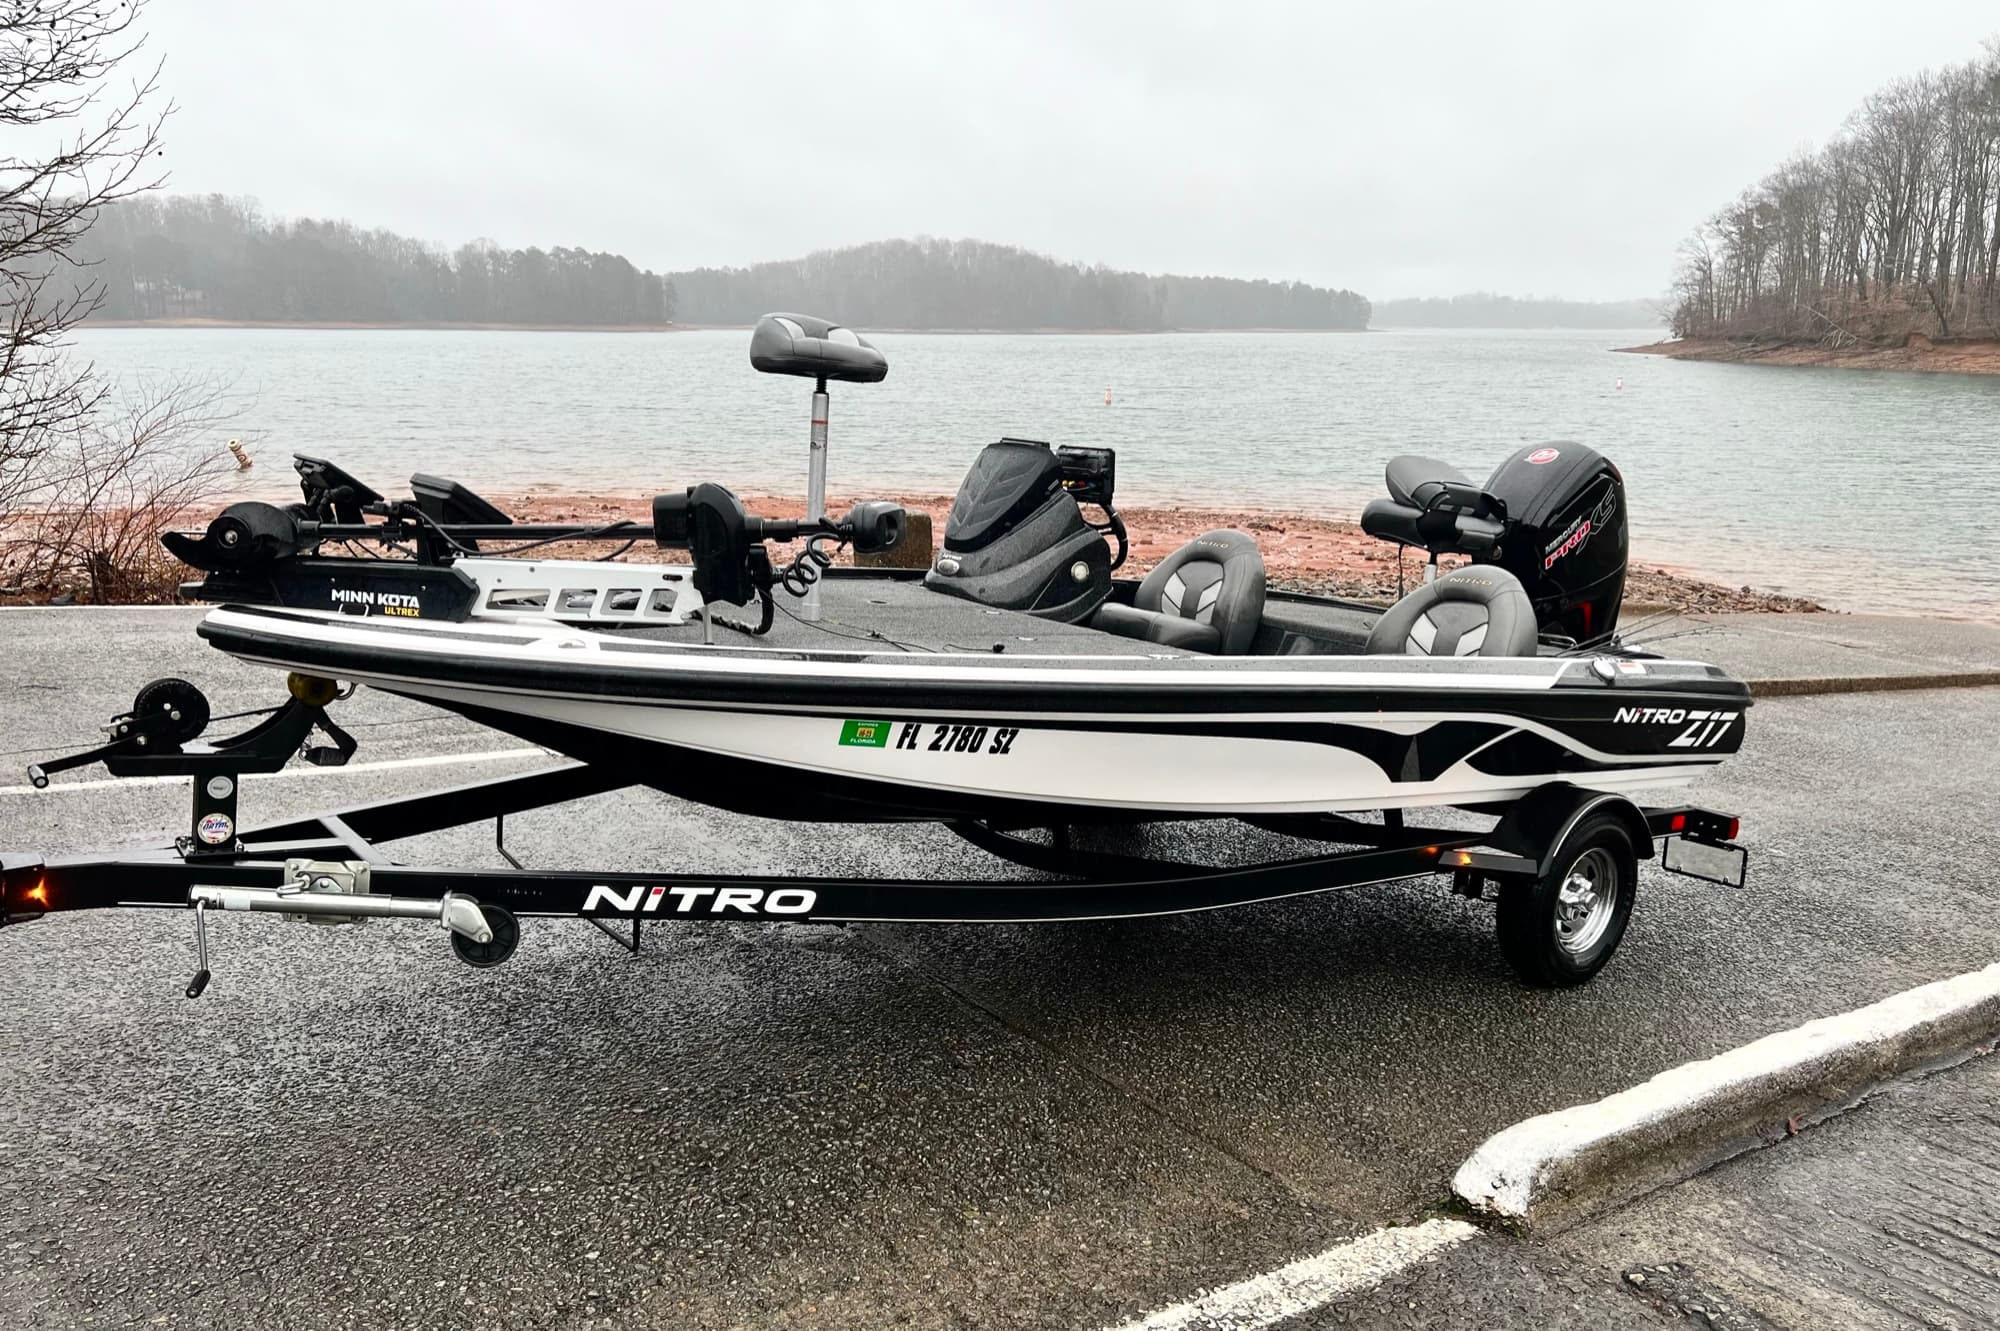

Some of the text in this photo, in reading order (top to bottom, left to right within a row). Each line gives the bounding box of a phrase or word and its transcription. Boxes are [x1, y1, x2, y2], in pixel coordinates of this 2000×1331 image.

[1545, 515, 1582, 554] MERCURY
[1545, 520, 1591, 570] PRO
[1449, 577, 1492, 586] NITRO
[331, 589, 420, 608] MINN KOTA
[384, 606, 420, 617] ULTREX
[896, 723, 1020, 755] FL 2780 SZ
[1613, 707, 1740, 747] NITRO Z17
[582, 885, 817, 914] NITRO
